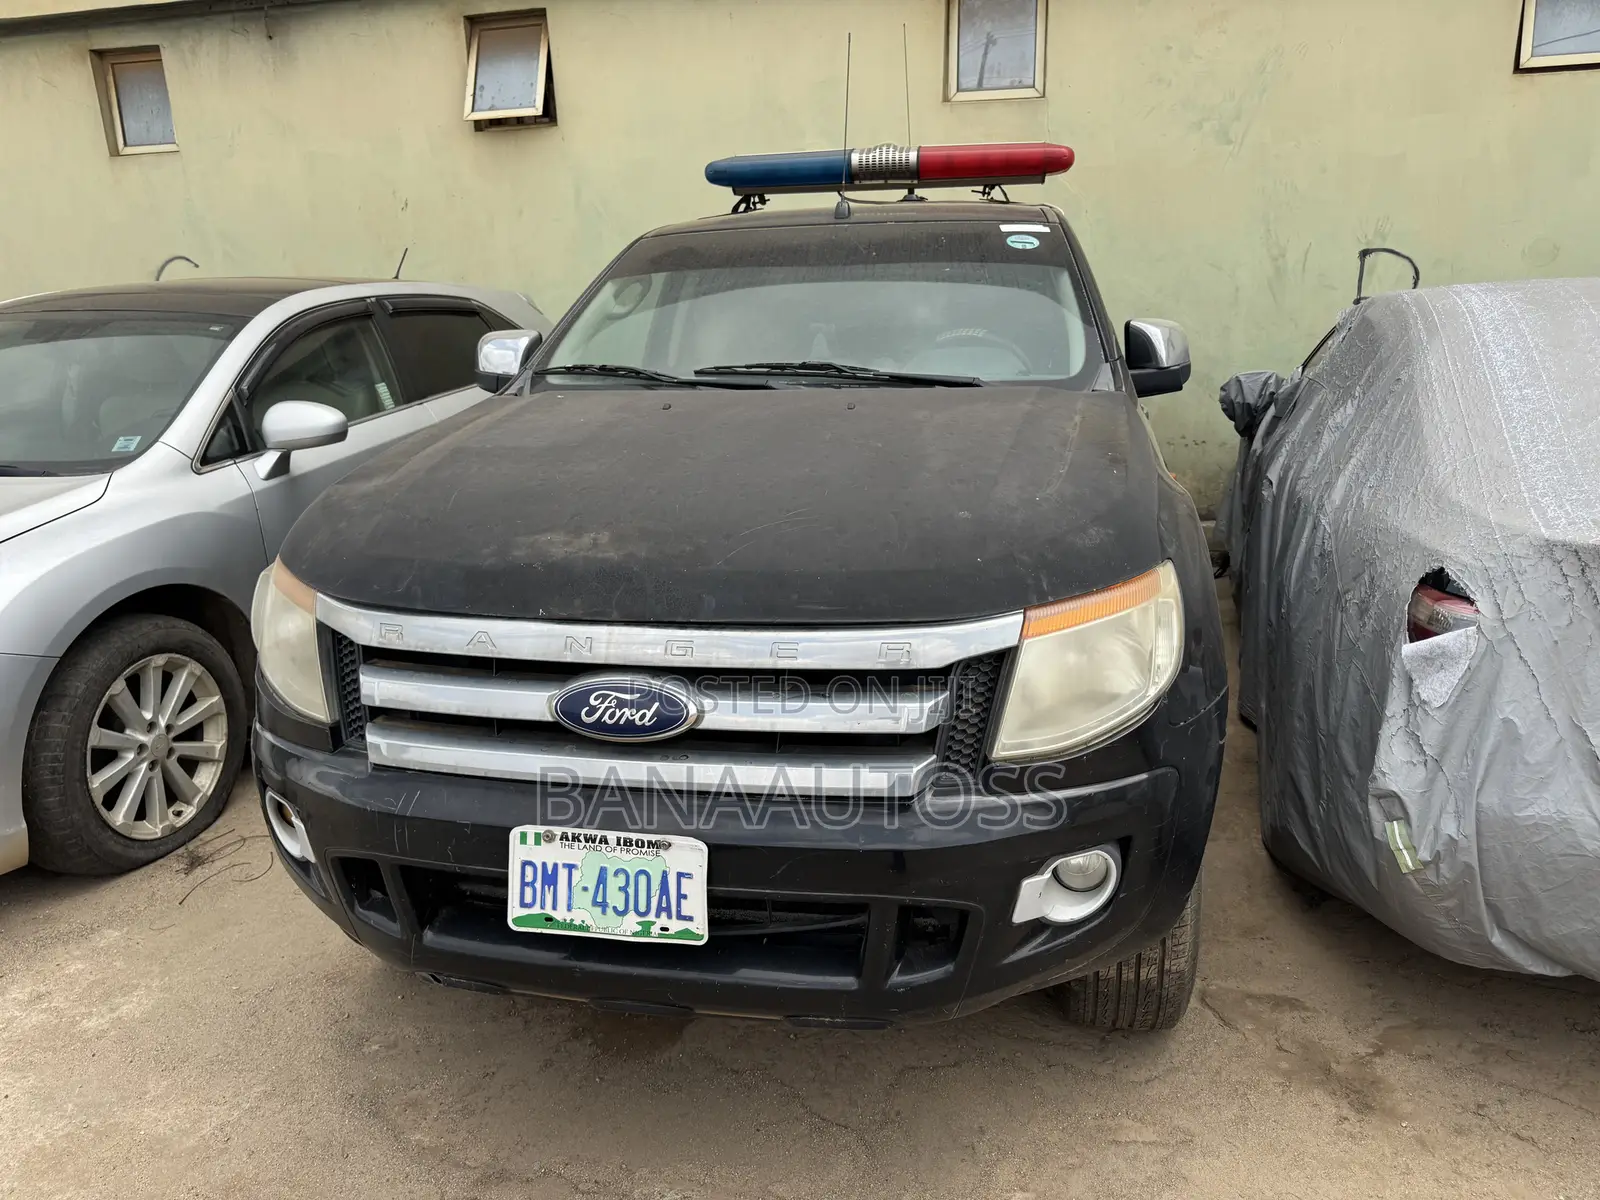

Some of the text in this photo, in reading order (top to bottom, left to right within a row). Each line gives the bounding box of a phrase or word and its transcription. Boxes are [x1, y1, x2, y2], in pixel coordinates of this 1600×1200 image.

[377, 622, 913, 665] RANGER
[580, 690, 660, 726] Ford
[559, 831, 662, 850] AKWA IBOM
[560, 841, 661, 858] THE LAND OF PROMISE
[519, 859, 694, 922] BMT-430AE
